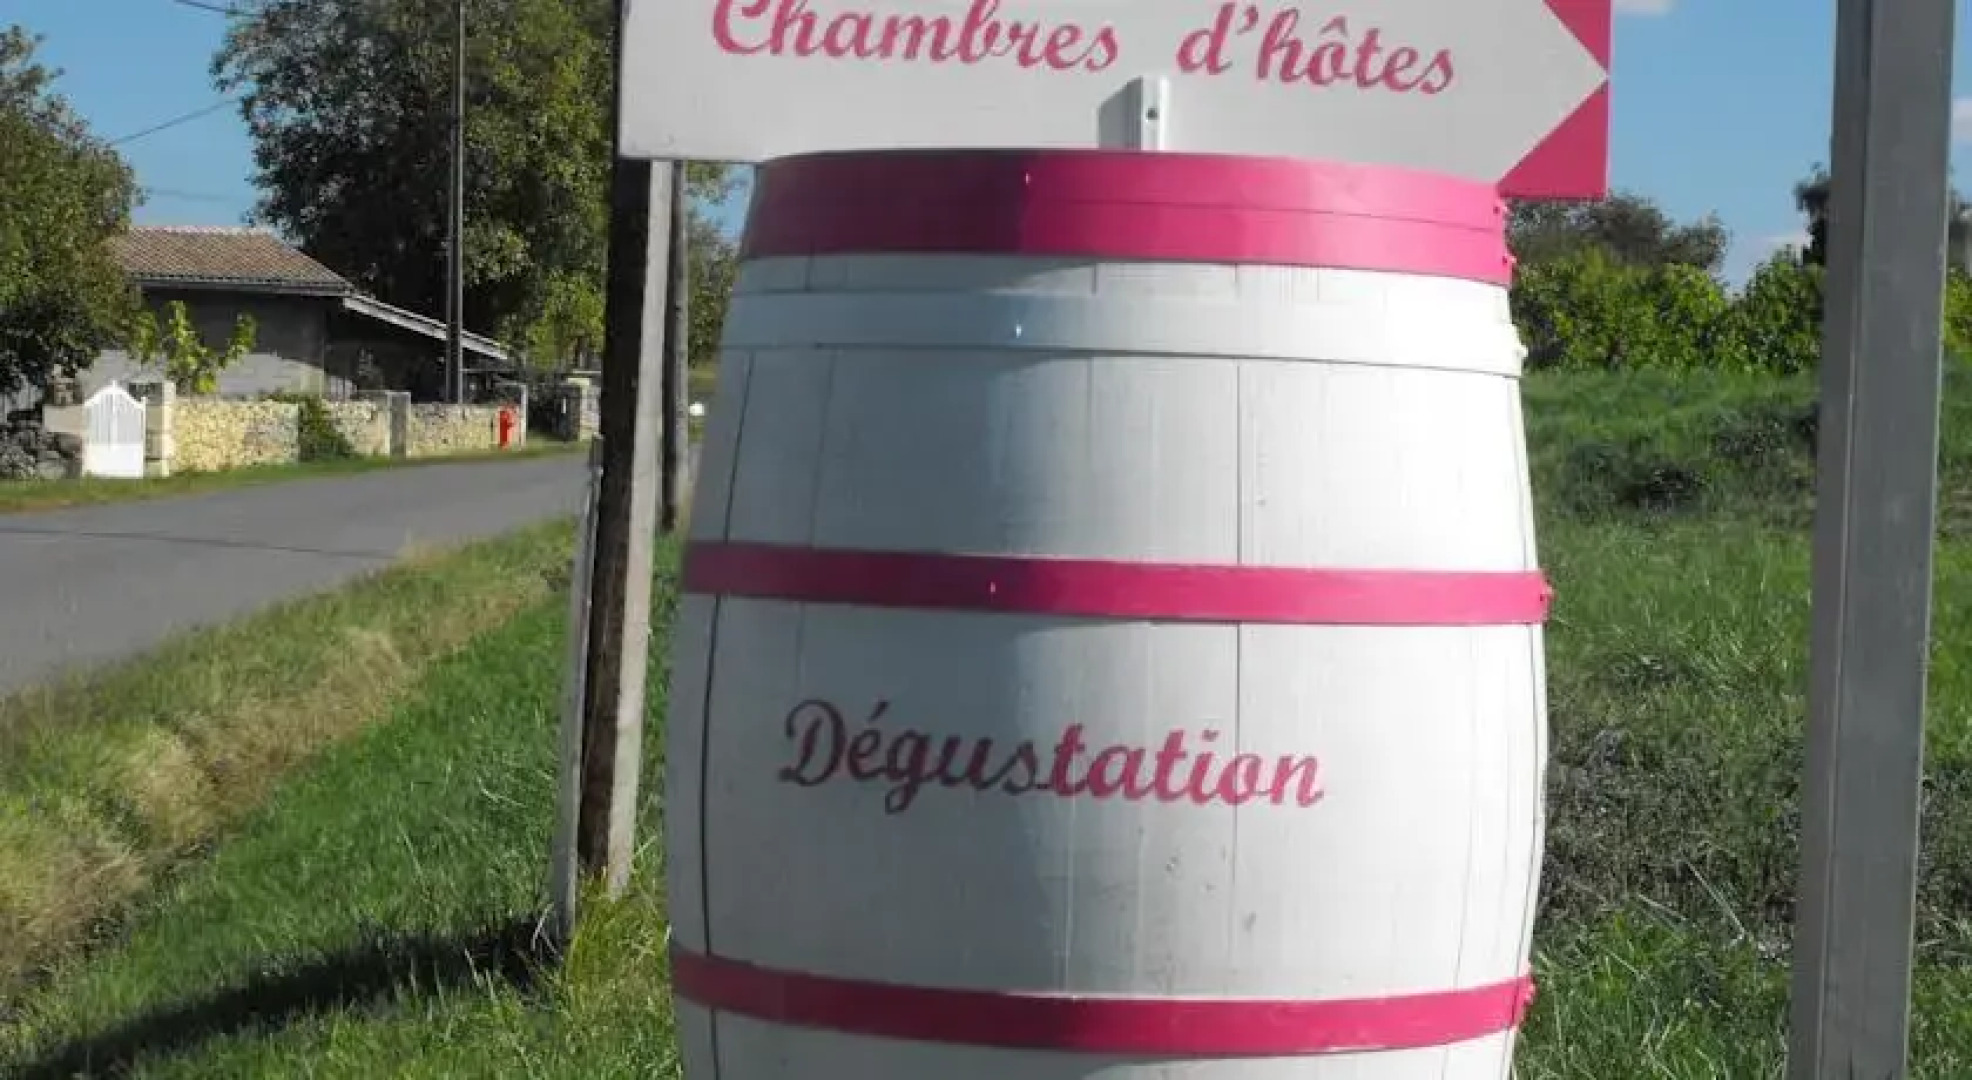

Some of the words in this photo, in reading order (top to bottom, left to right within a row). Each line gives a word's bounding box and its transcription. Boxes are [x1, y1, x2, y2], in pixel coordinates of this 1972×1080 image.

[712, 0, 1119, 70] Chambres
[1176, 2, 1456, 94] d'hôtes
[779, 699, 1325, 814] Dégustation
